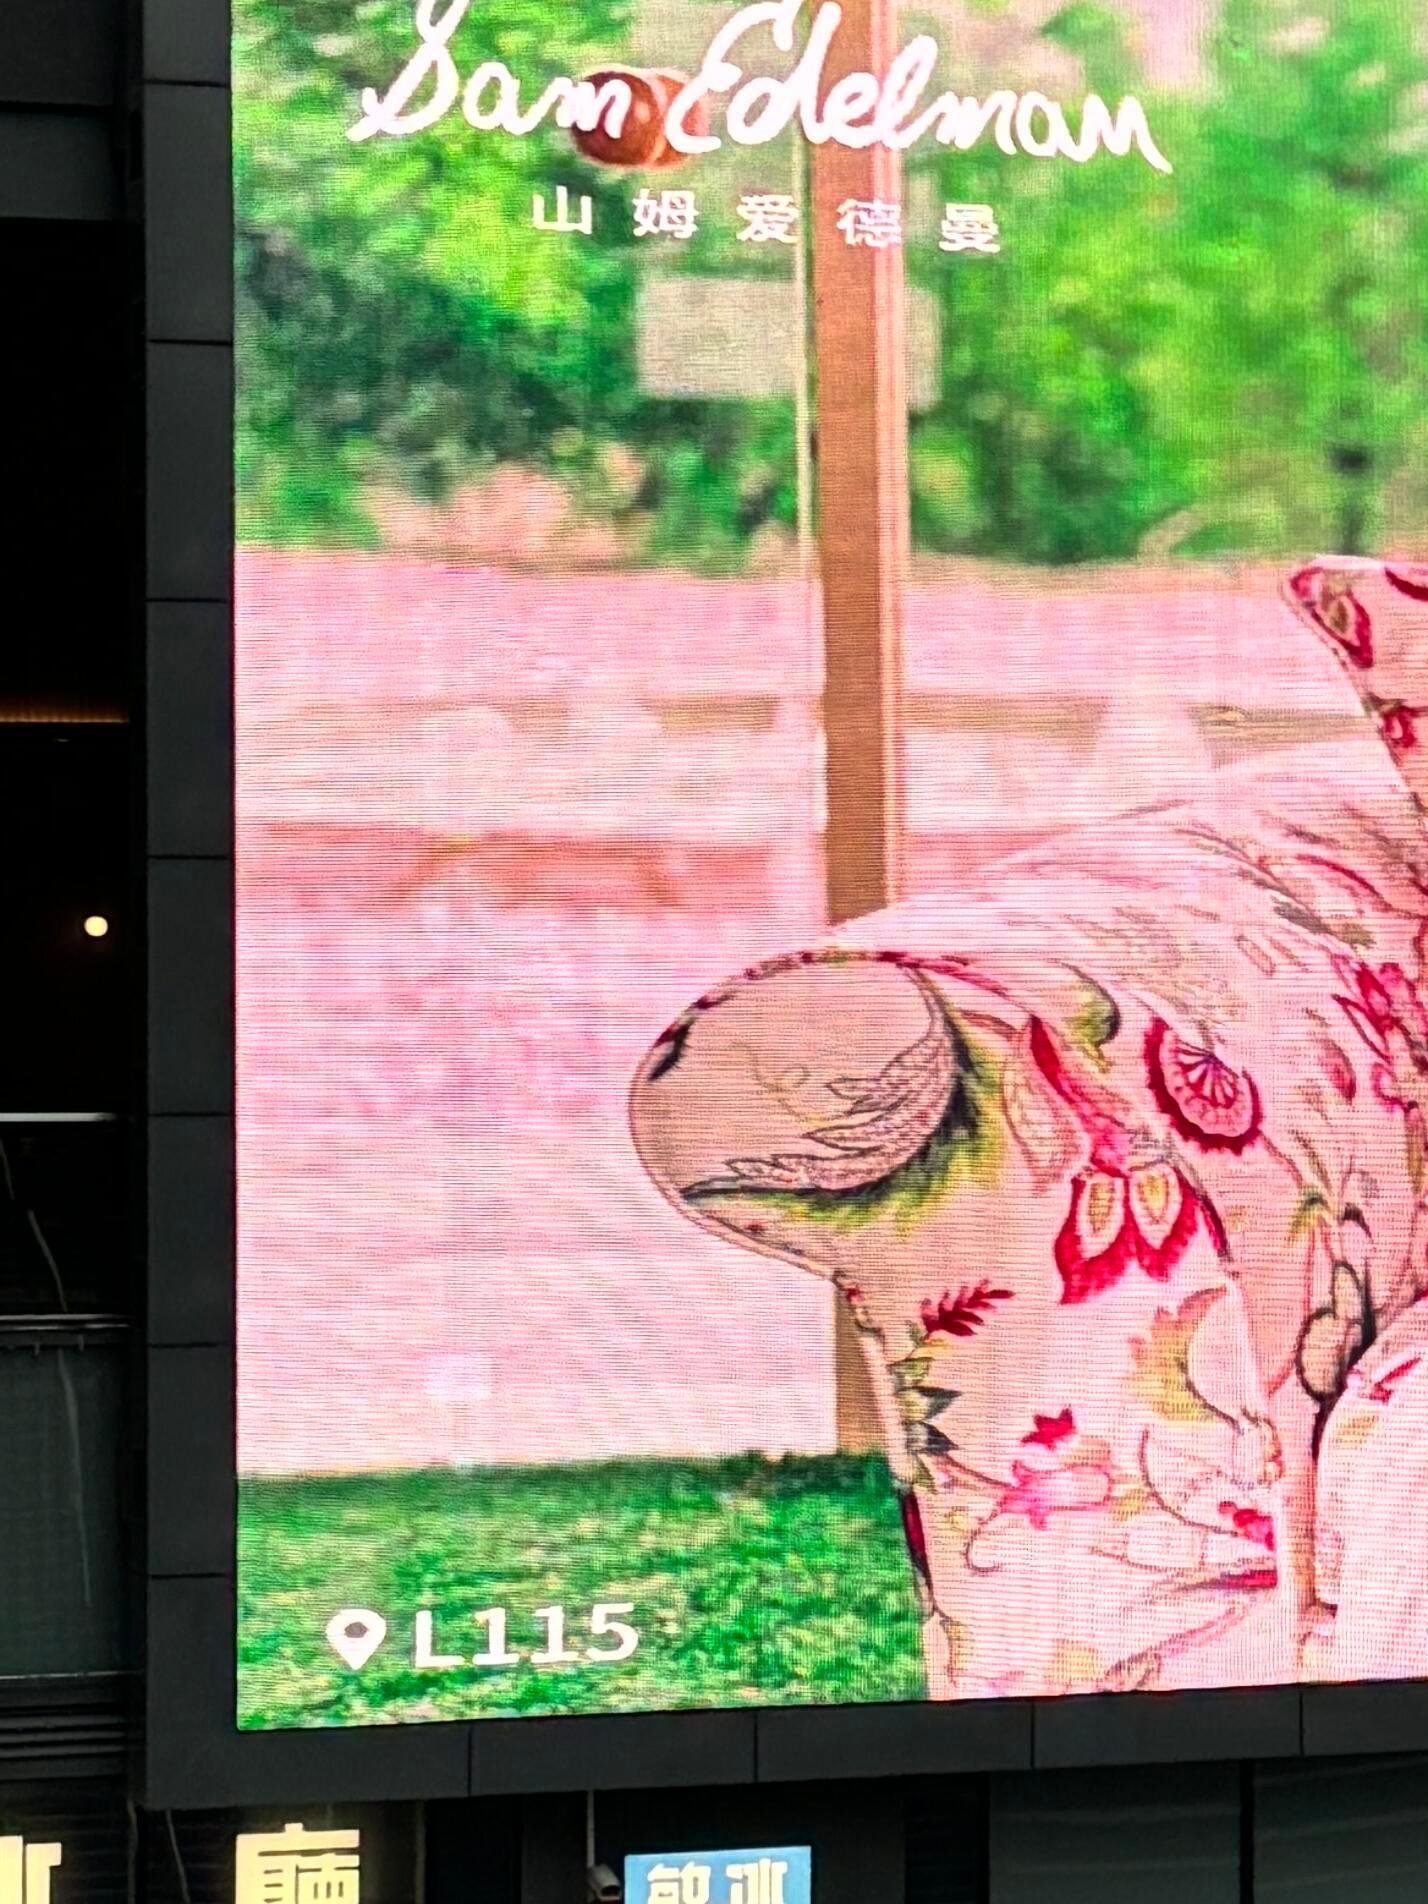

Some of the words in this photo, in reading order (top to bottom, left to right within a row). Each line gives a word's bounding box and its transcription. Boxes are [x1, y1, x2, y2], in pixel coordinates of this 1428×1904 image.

[529, 183, 1003, 255] 山姆爱德曼
[415, 1602, 640, 1669] L115
